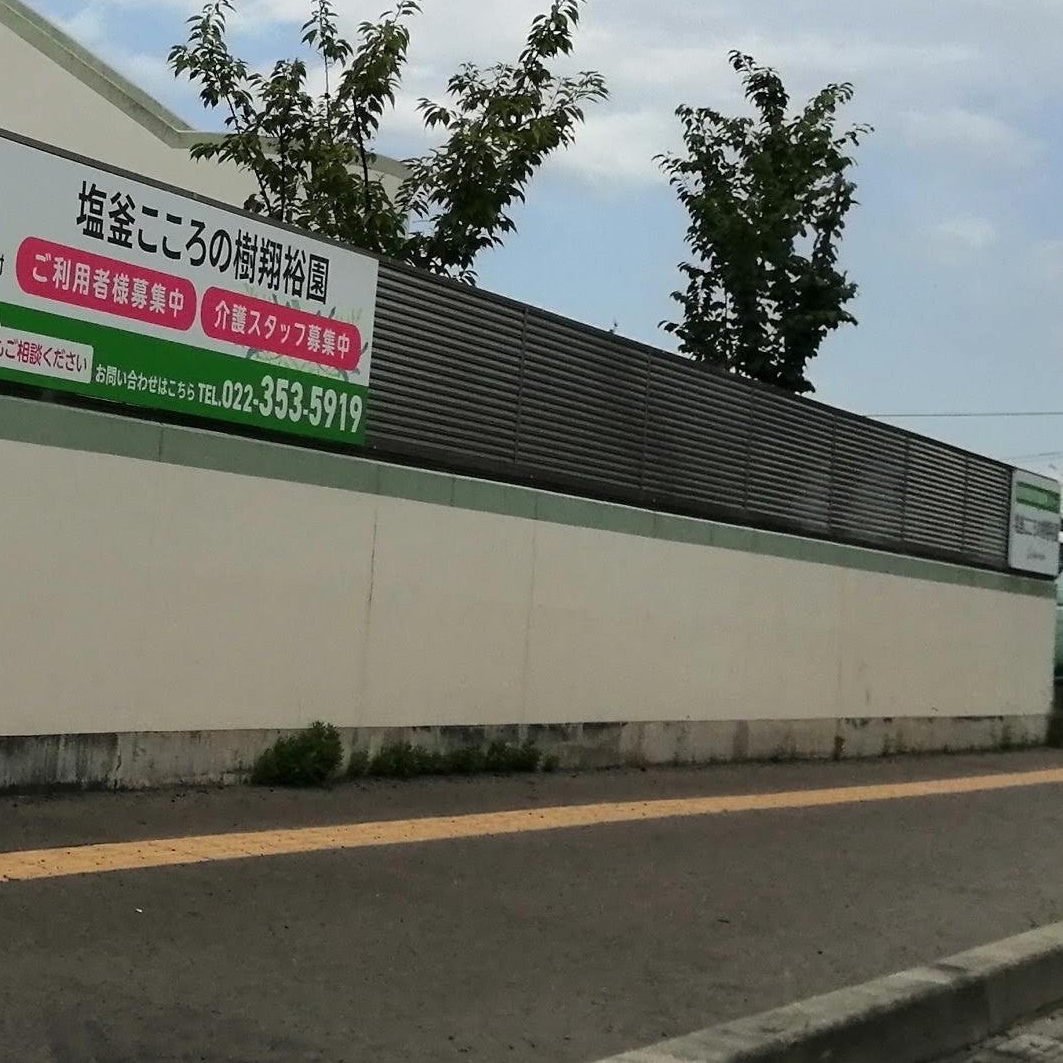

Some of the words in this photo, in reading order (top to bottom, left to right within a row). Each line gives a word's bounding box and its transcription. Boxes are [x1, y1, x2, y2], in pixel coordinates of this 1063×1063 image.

[76, 181, 329, 304] 塩釜こころの樹翔裕園
[32, 253, 184, 318] ご利用者様募集中
[214, 300, 350, 359] 介護スタッフ募集中
[95, 365, 195, 402] お問い合わせはこちら
